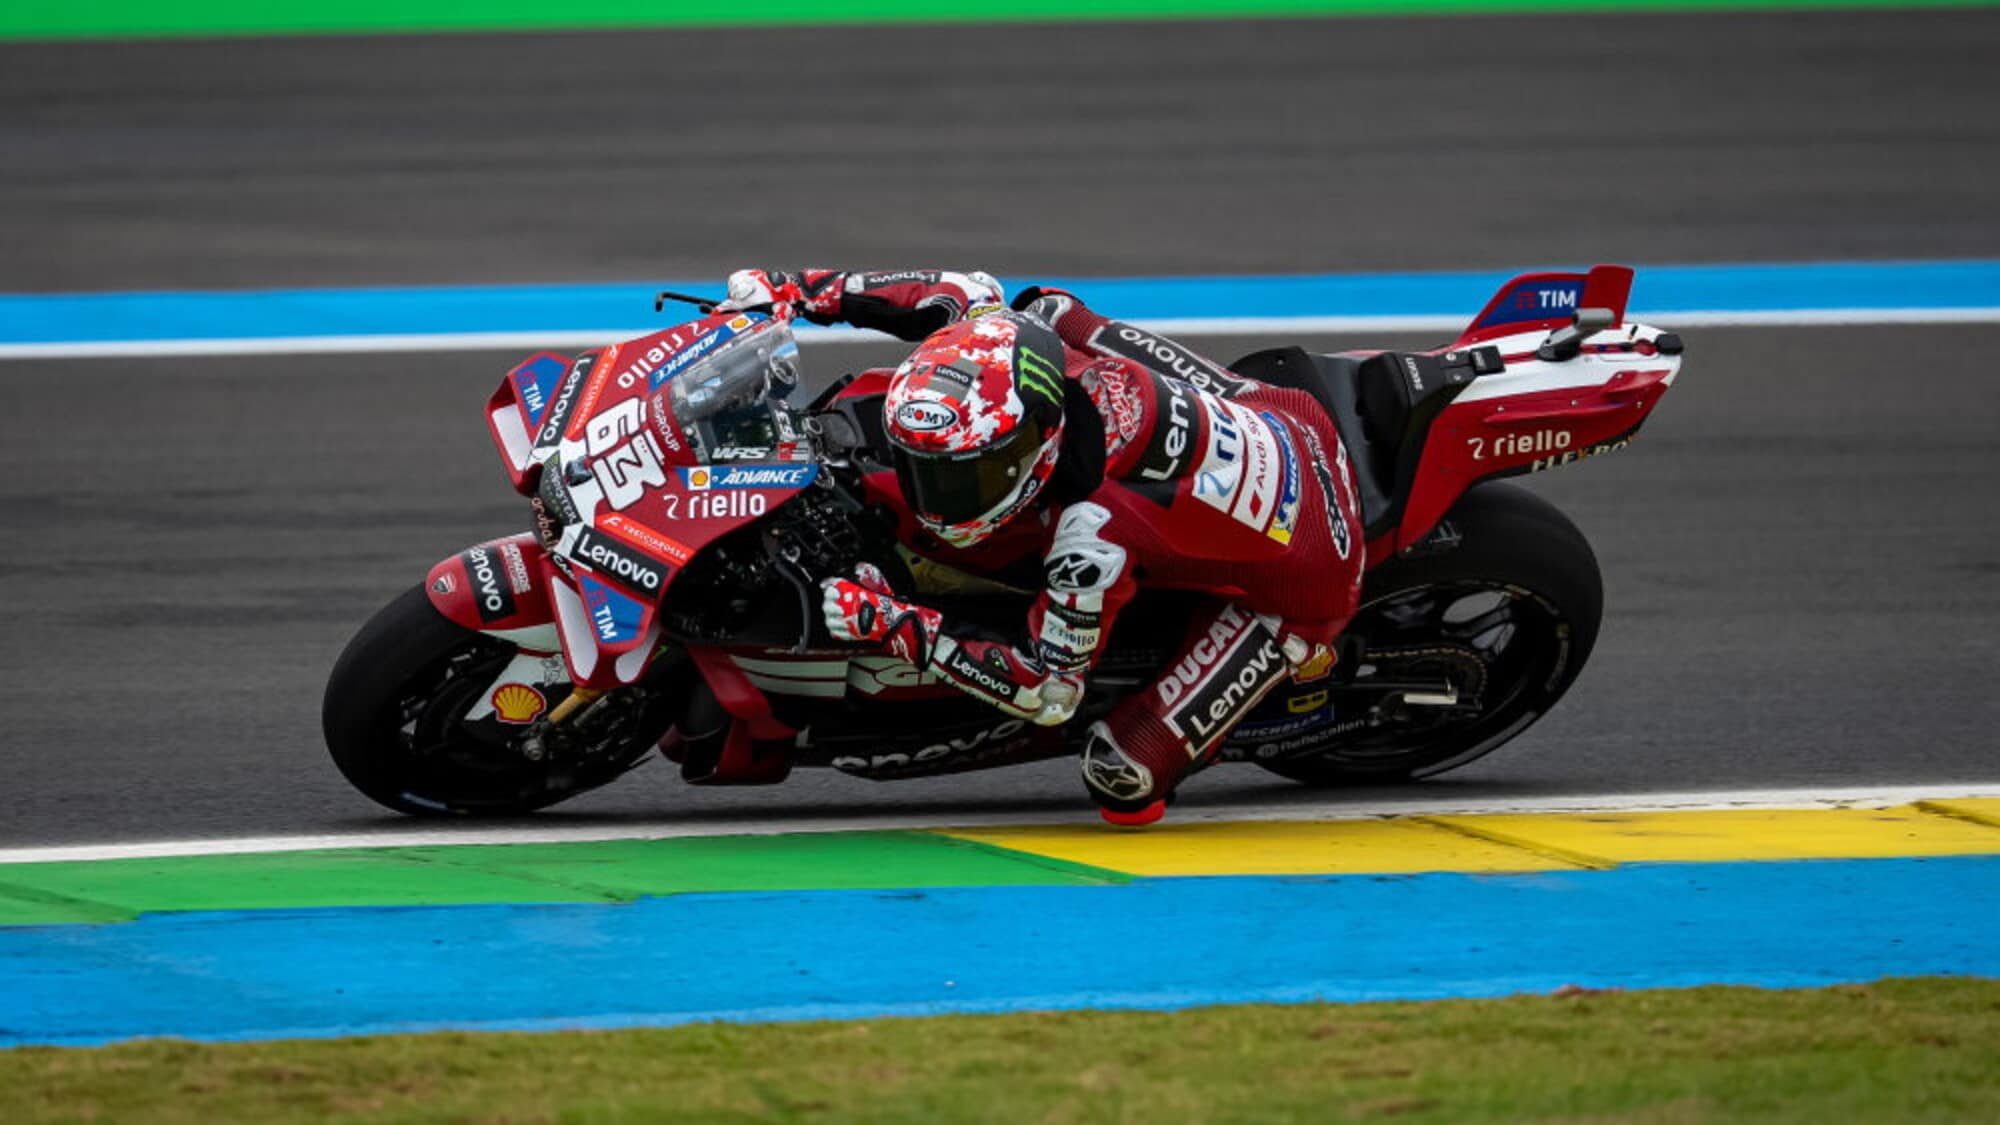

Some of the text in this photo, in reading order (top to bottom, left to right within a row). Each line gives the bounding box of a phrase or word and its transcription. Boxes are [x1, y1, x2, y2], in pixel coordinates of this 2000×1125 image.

[1538, 290, 1576, 308] TIM
[617, 333, 686, 389] riello
[936, 366, 969, 384] Lenovo
[1119, 328, 1227, 398] Lenovo
[523, 382, 544, 413] TIM
[543, 358, 592, 441] Lenovo
[585, 396, 667, 511] 63
[711, 447, 770, 459] WRS
[1252, 440, 1268, 489] Audi
[1494, 430, 1572, 456] riello
[720, 467, 804, 485] ADVANCE
[688, 490, 767, 519] riello
[470, 546, 503, 611] enovo
[577, 533, 659, 589] Lenovo
[595, 605, 618, 640] TIM
[952, 652, 1012, 696] Lenovo
[1157, 603, 1252, 706] DUCAT
